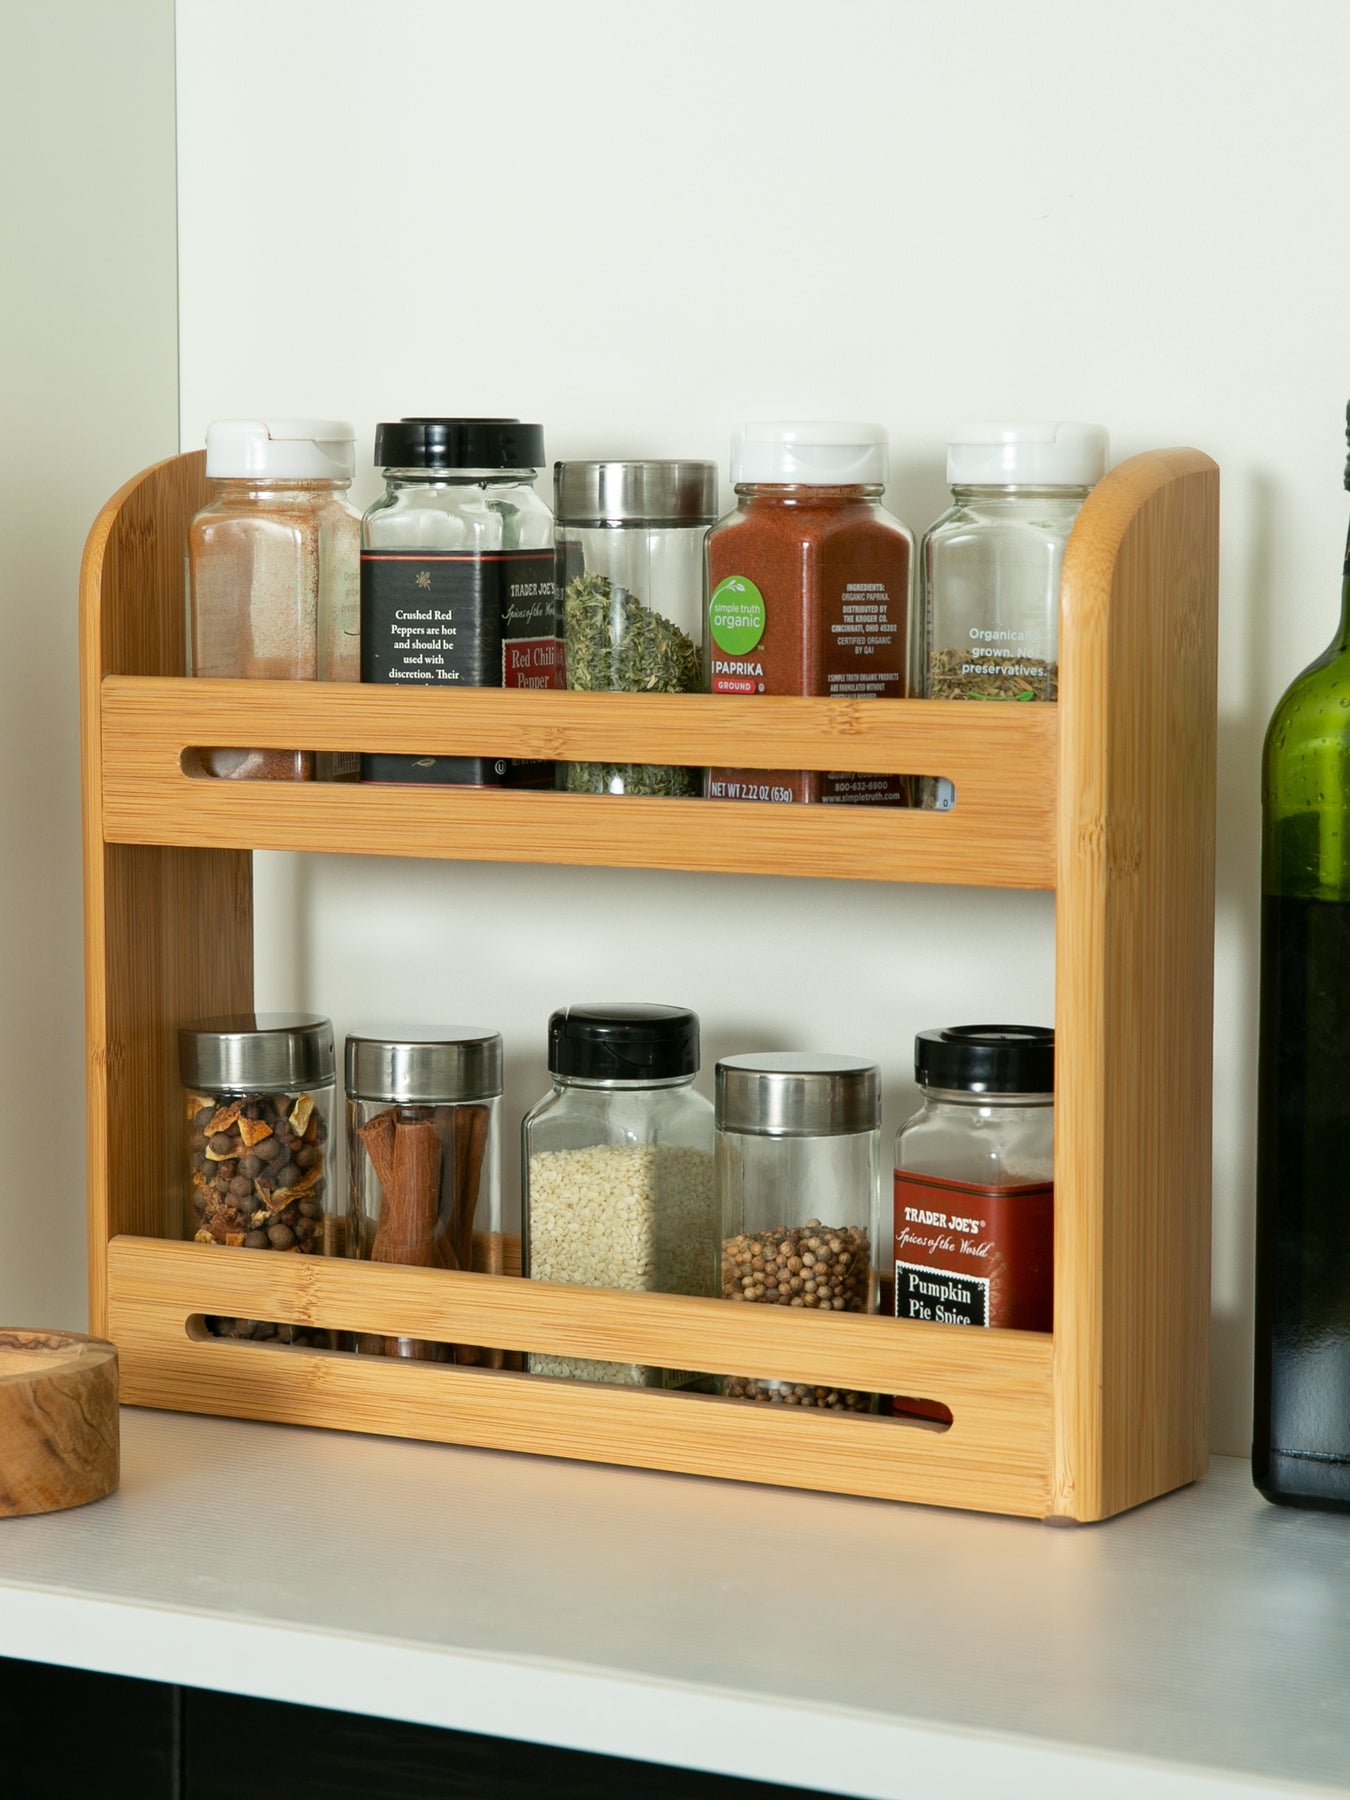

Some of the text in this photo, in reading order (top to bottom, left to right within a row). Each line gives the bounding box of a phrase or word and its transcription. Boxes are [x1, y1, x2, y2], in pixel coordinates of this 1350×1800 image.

[511, 584, 538, 597] TRADER
[846, 583, 885, 592] INGREDIENTS:
[842, 593, 865, 601] ORGANIC
[395, 609, 452, 620] Crushed Red
[714, 604, 760, 614] simple truth
[842, 605, 888, 613] DISTRIBUTED BY
[714, 615, 760, 629] organic
[843, 614, 888, 623] THE KROGER CO.
[391, 624, 425, 637] Peppers
[441, 625, 457, 635] hot
[831, 624, 898, 634] CINCINNATI, OHIO 45202
[394, 639, 454, 650] and should be
[837, 636, 892, 645] CERTIFIED ORGANIC
[855, 646, 874, 654] BY QAI
[972, 647, 1034, 658] grown. No
[403, 654, 445, 665] used with
[512, 647, 555, 668] Red Chili
[389, 668, 460, 679] discretion. Their
[716, 661, 764, 676] PAPRIKA
[962, 664, 1048, 677] preservatives.
[717, 681, 751, 691] GROUND
[711, 782, 726, 797] NET
[728, 783, 740, 798] WT
[741, 784, 758, 799] 2.22
[759, 786, 770, 800] OZ
[835, 781, 888, 792] 800-632-6900
[822, 792, 900, 803] www.simpletruth.com
[904, 1206, 947, 1228] TRADER
[896, 1227, 995, 1258] Spices of the World
[908, 1273, 971, 1304] Pumpkin
[909, 1299, 971, 1325] Pie Spice
